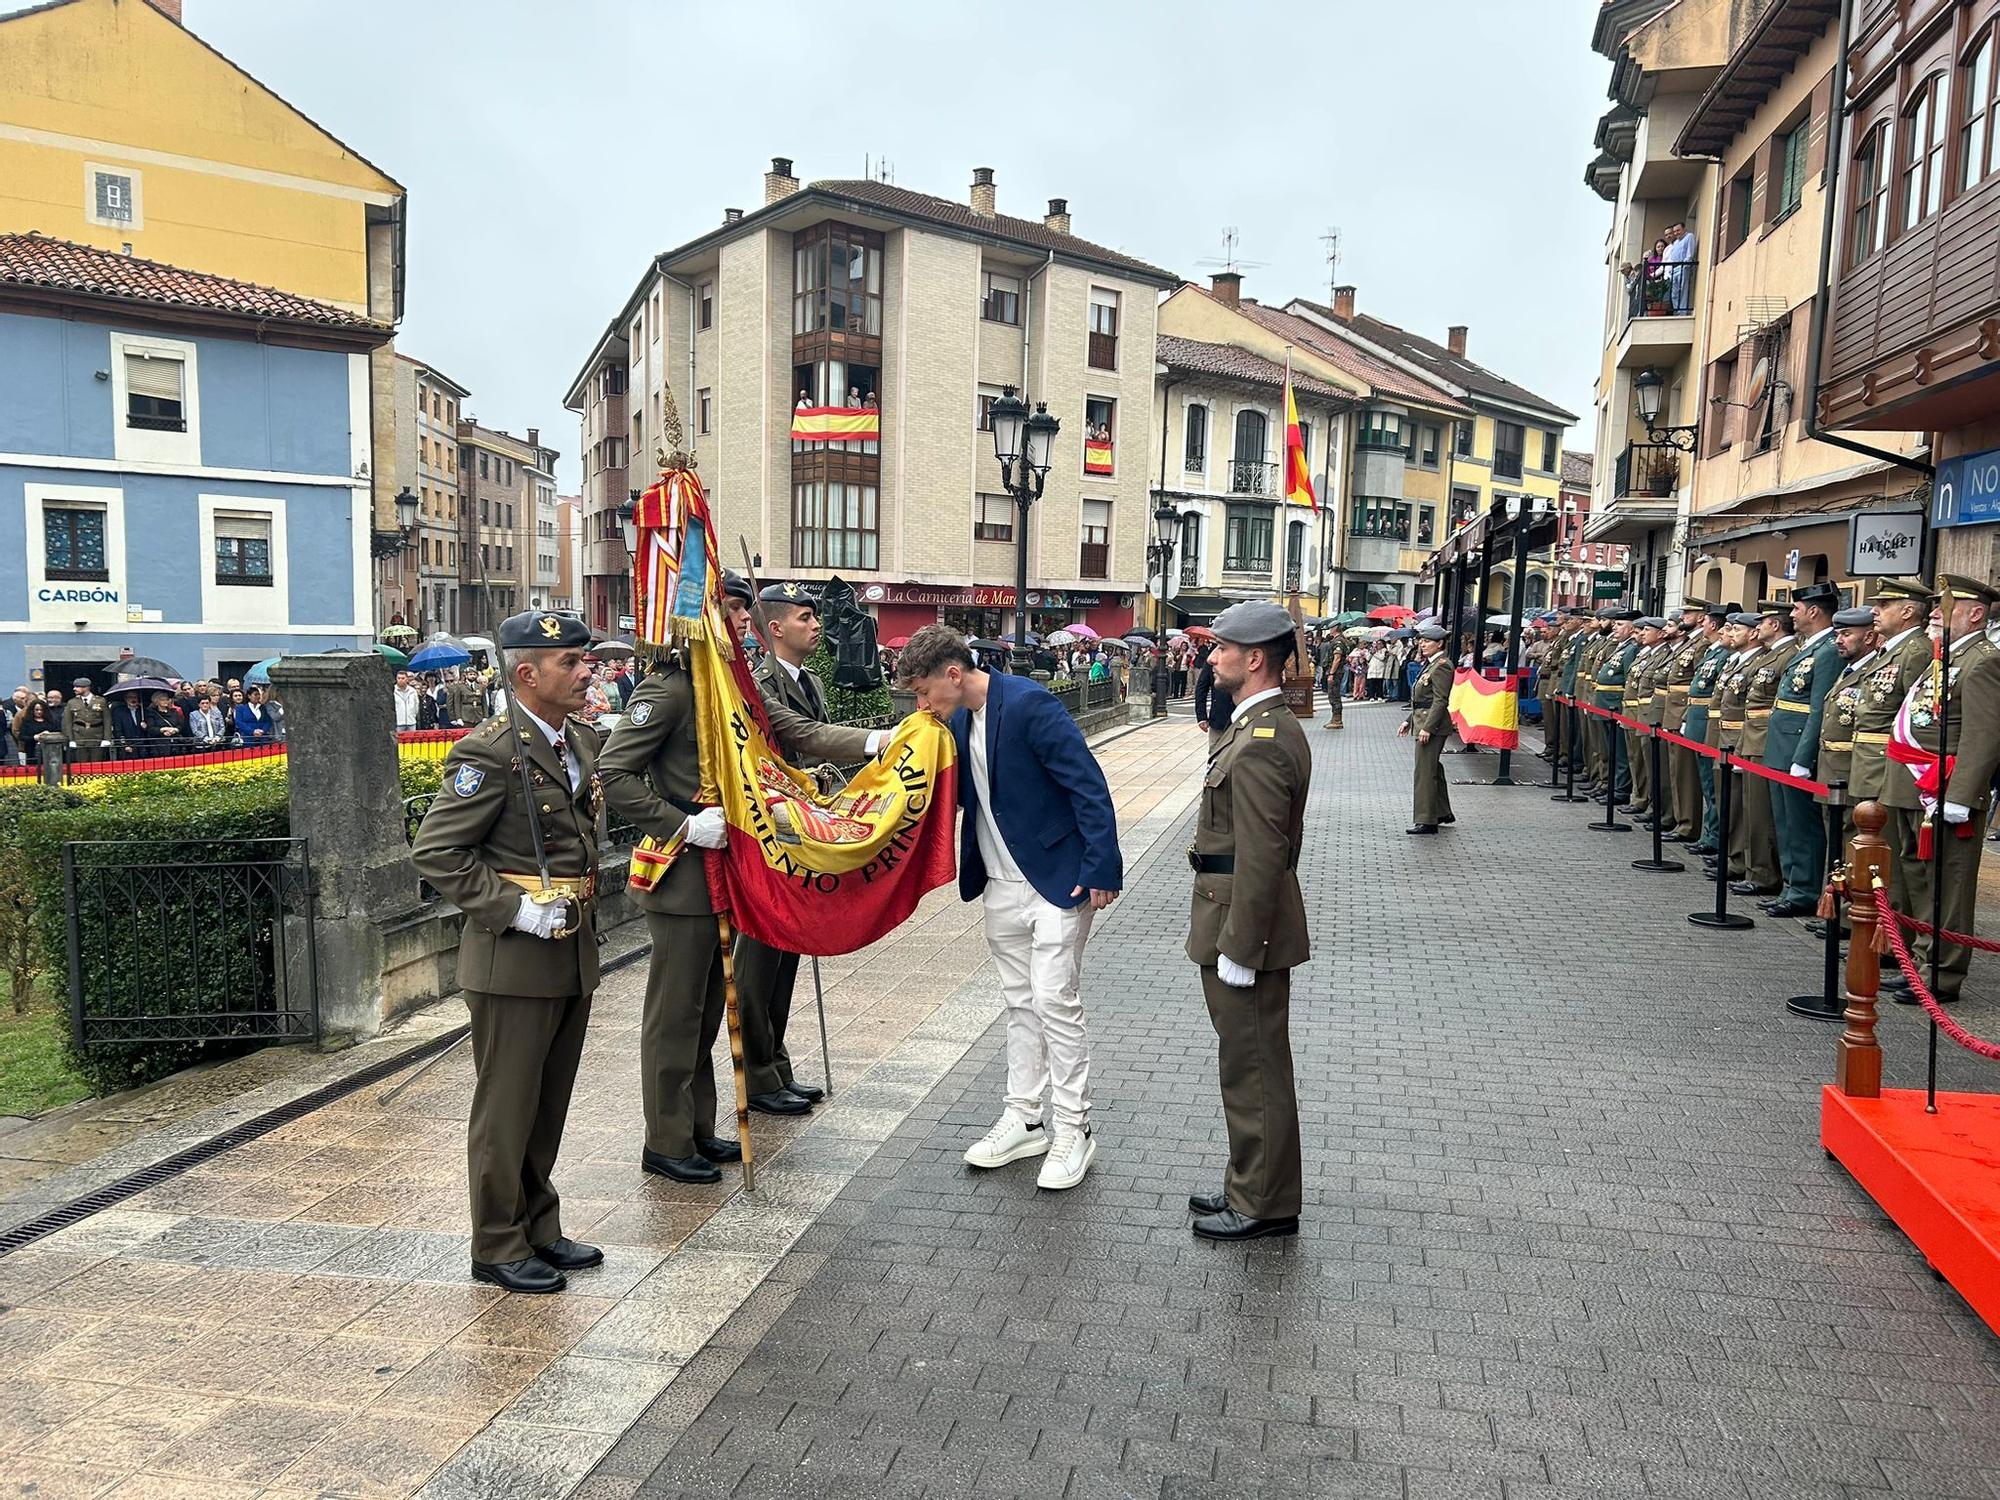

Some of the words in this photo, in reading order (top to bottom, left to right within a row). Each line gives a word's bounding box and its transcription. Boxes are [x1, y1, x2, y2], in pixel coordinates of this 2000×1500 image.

[1859, 536, 1916, 554] HATCHET
[38, 586, 118, 603] CARBÓN
[886, 587, 904, 602] La
[906, 588, 973, 605] Carnicería
[975, 589, 988, 605] de
